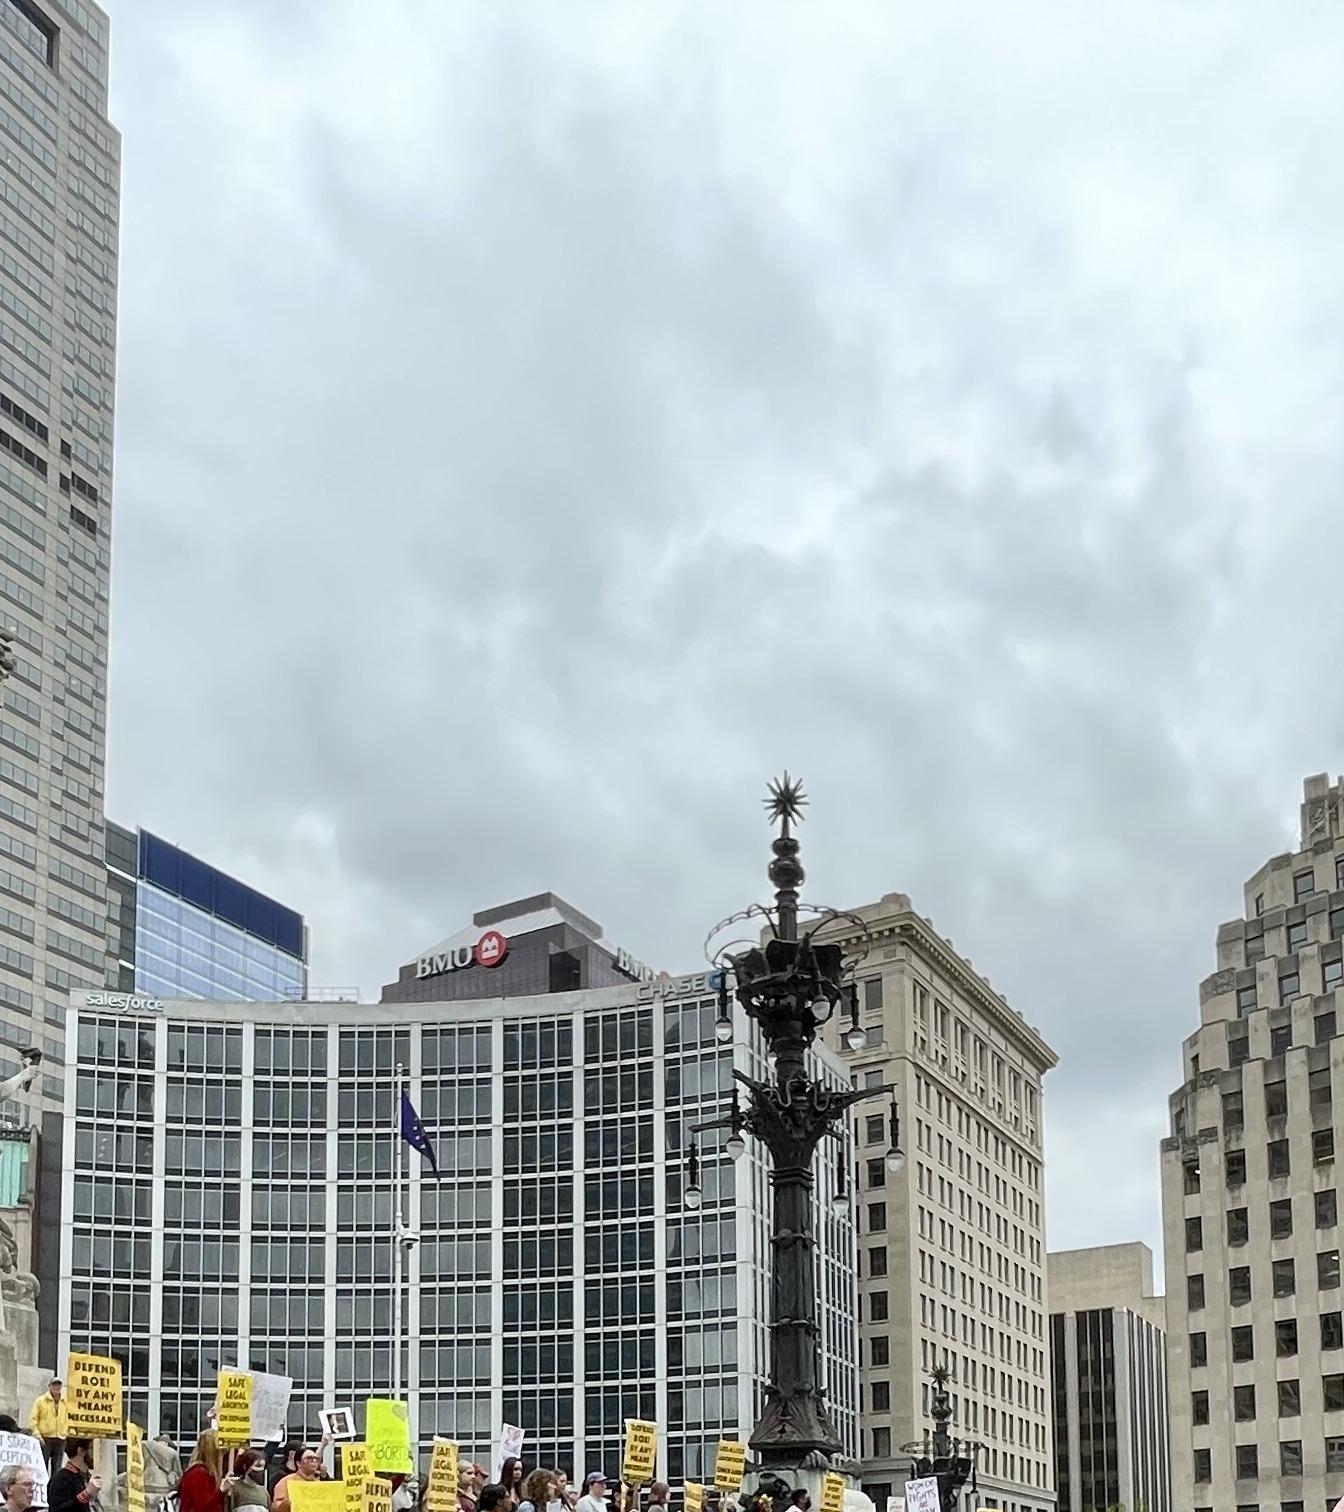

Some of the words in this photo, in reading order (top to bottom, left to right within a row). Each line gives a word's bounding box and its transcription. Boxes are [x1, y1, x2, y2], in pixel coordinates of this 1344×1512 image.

[416, 945, 473, 979] BMO
[636, 975, 706, 1001] CHASE
[74, 1361, 116, 1375] DEFEND
[93, 1390, 116, 1401] ANY
[77, 1401, 113, 1412] MEANS
